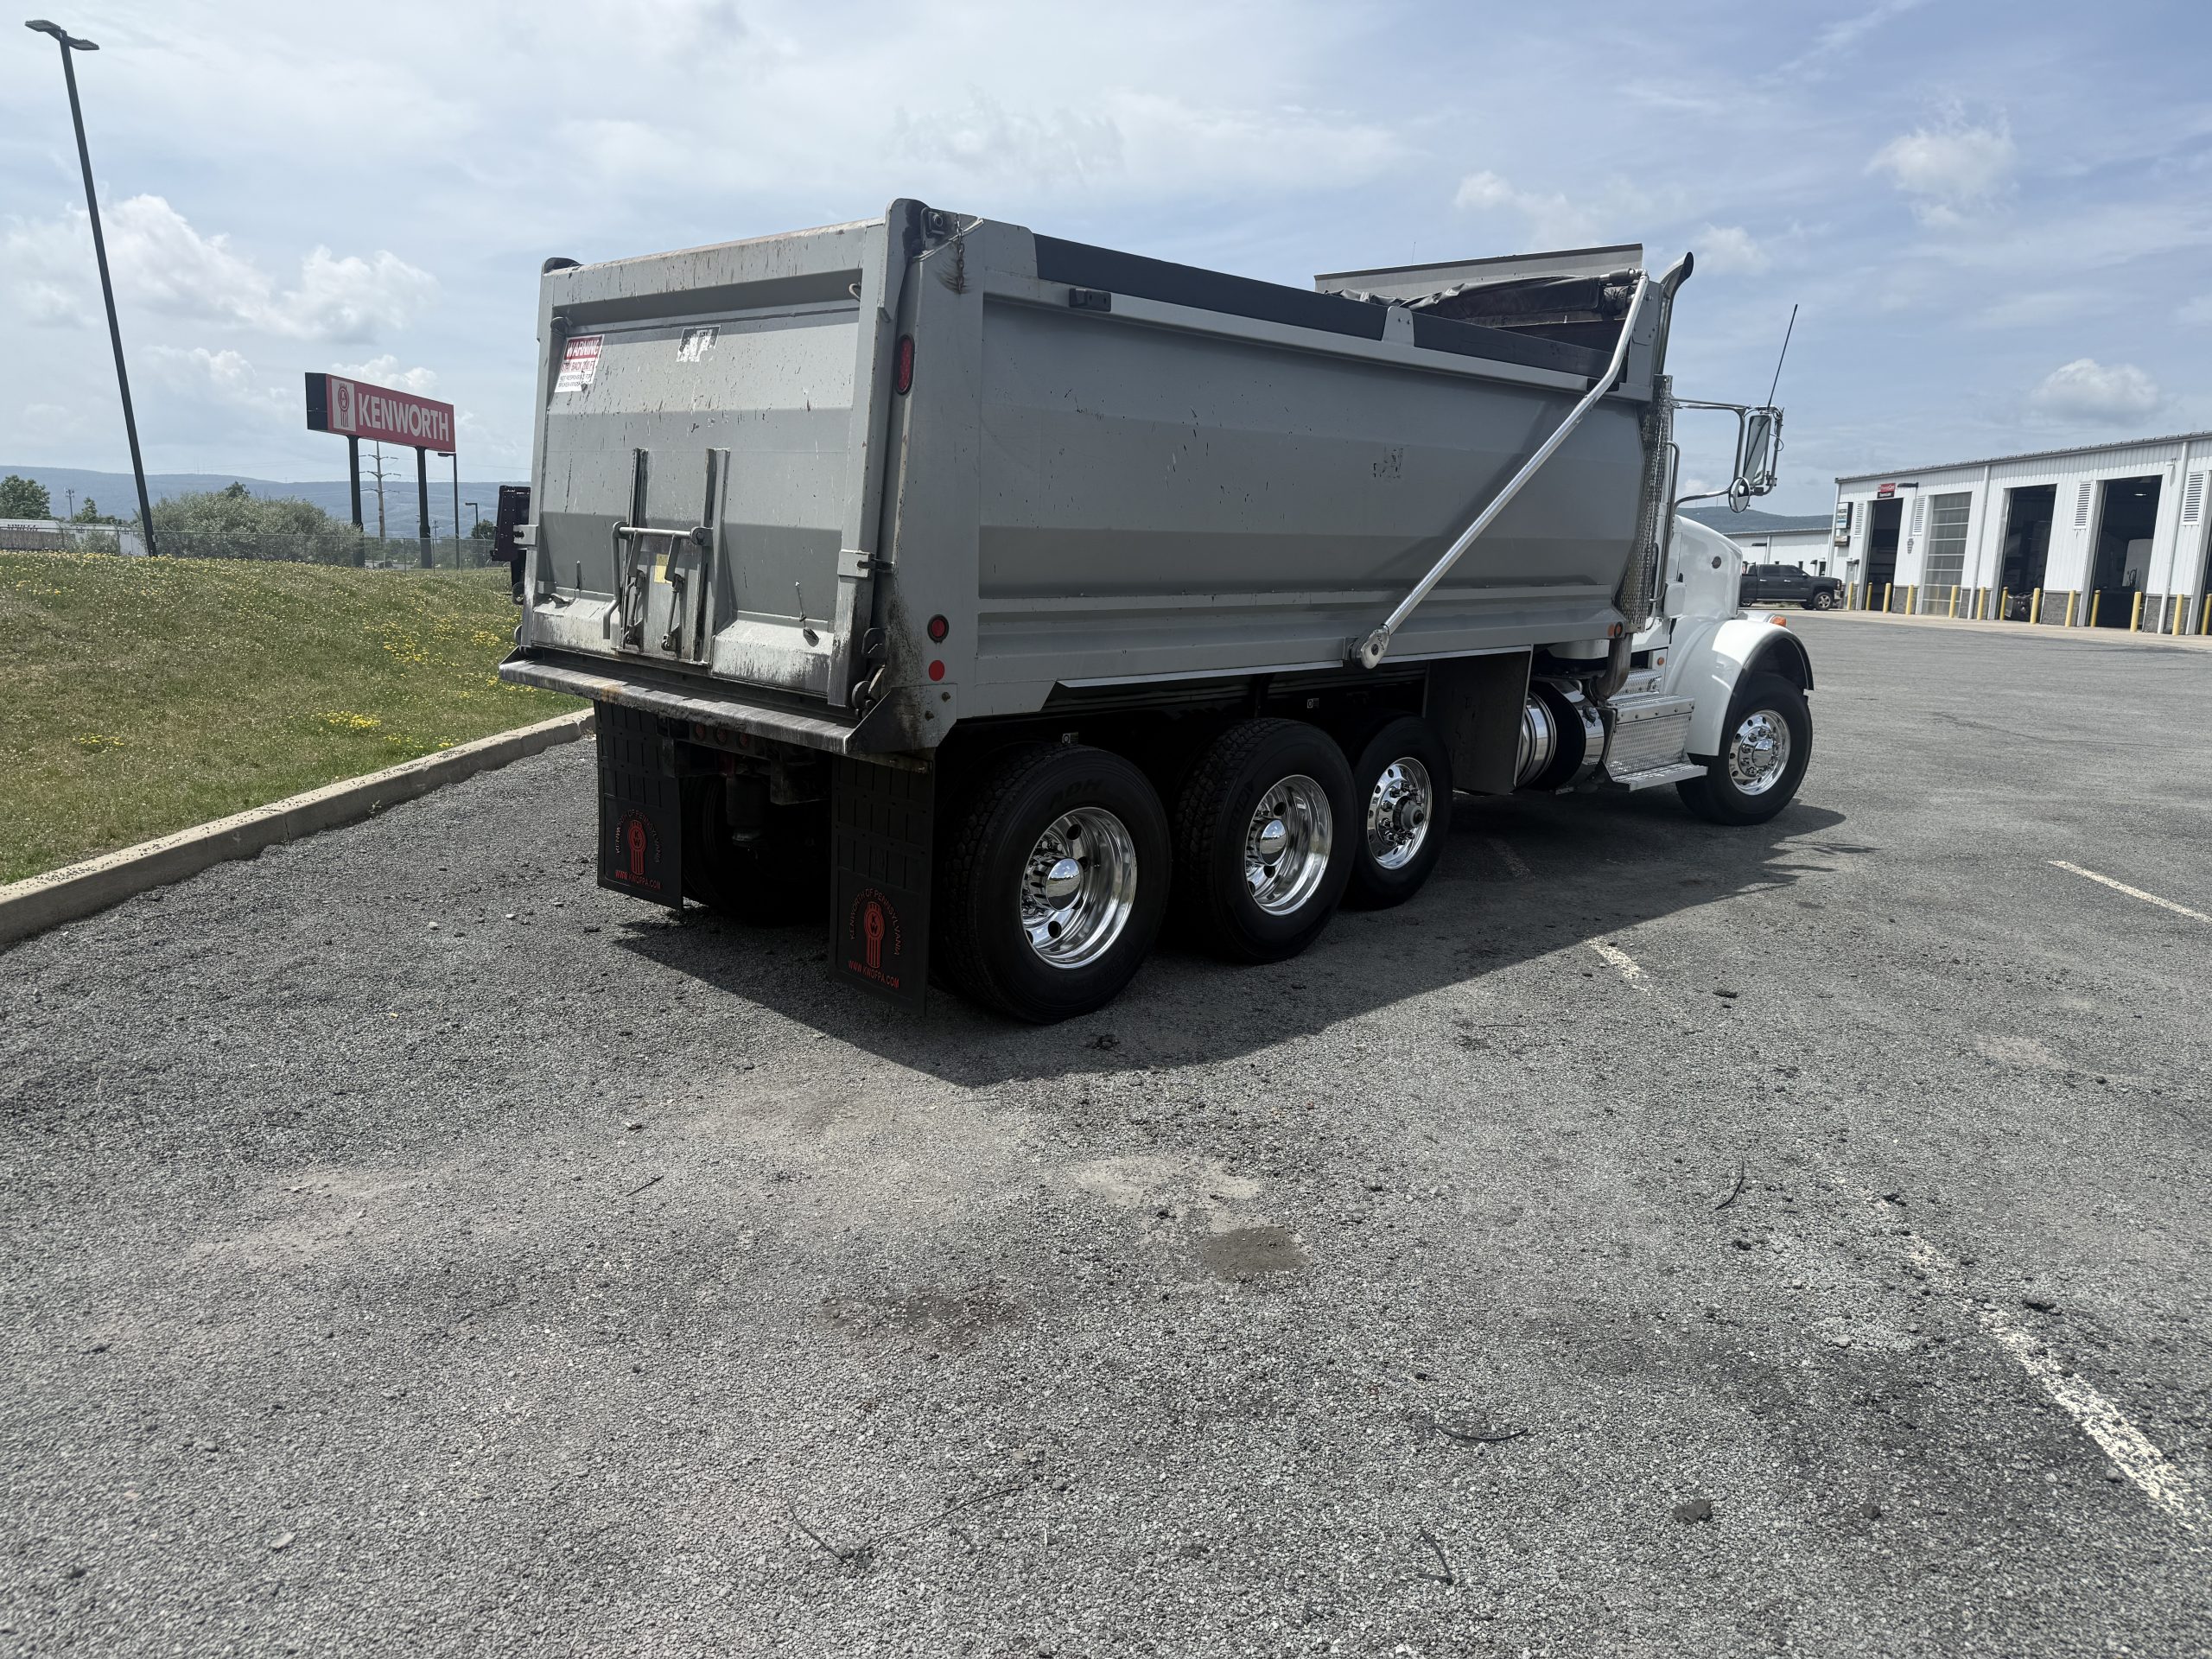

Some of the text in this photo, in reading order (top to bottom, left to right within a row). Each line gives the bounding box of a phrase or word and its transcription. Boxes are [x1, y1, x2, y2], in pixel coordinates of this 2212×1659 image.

[566, 340, 600, 357] WARNING
[358, 392, 449, 442] KENWORTH
[849, 888, 904, 956] KENWORTH OF PENNSYLVANIA
[849, 960, 899, 988] WWW.KWOFPA.COM
